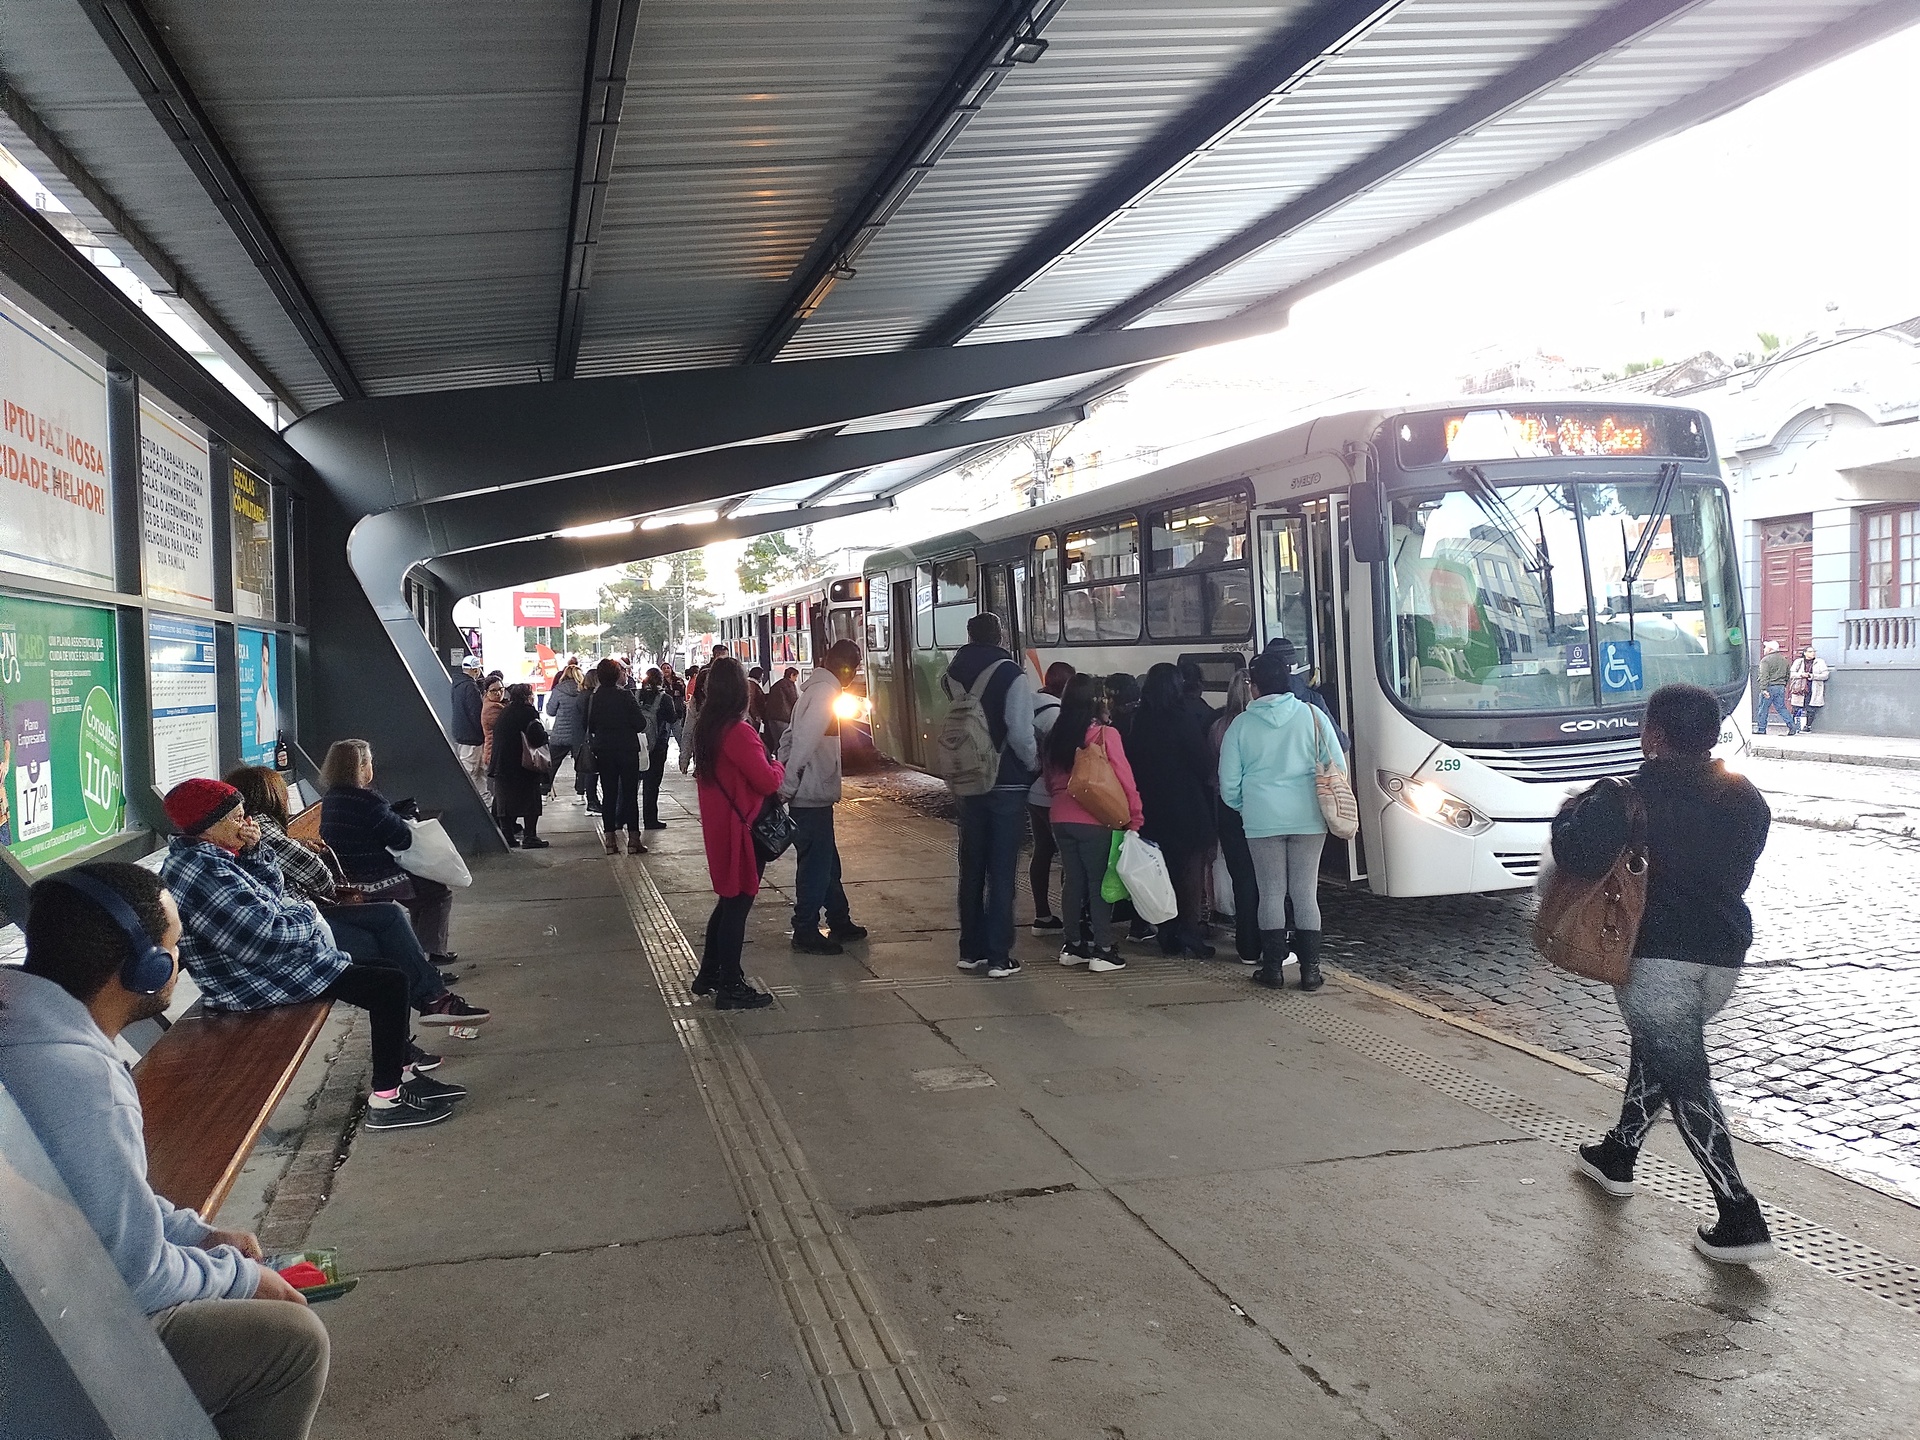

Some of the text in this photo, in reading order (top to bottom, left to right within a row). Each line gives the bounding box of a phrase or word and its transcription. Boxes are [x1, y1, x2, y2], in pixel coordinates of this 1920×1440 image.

[4, 399, 35, 442] IPTU
[66, 432, 105, 477] NOSSA
[164, 466, 171, 481] DO
[1290, 472, 1321, 489] SVELTO
[52, 466, 105, 515] MELHOR!
[233, 468, 255, 497] ESCOLAS
[153, 513, 160, 528] DE
[195, 514, 204, 530] NOS
[171, 537, 183, 554] PARA
[95, 638, 103, 651] QUE
[24, 719, 39, 731] Plano
[86, 705, 118, 749] Consultas
[1560, 718, 1639, 733] COMIL
[18, 730, 46, 748] Empresarial
[1718, 732, 1733, 744] 259
[1435, 759, 1461, 772] 259
